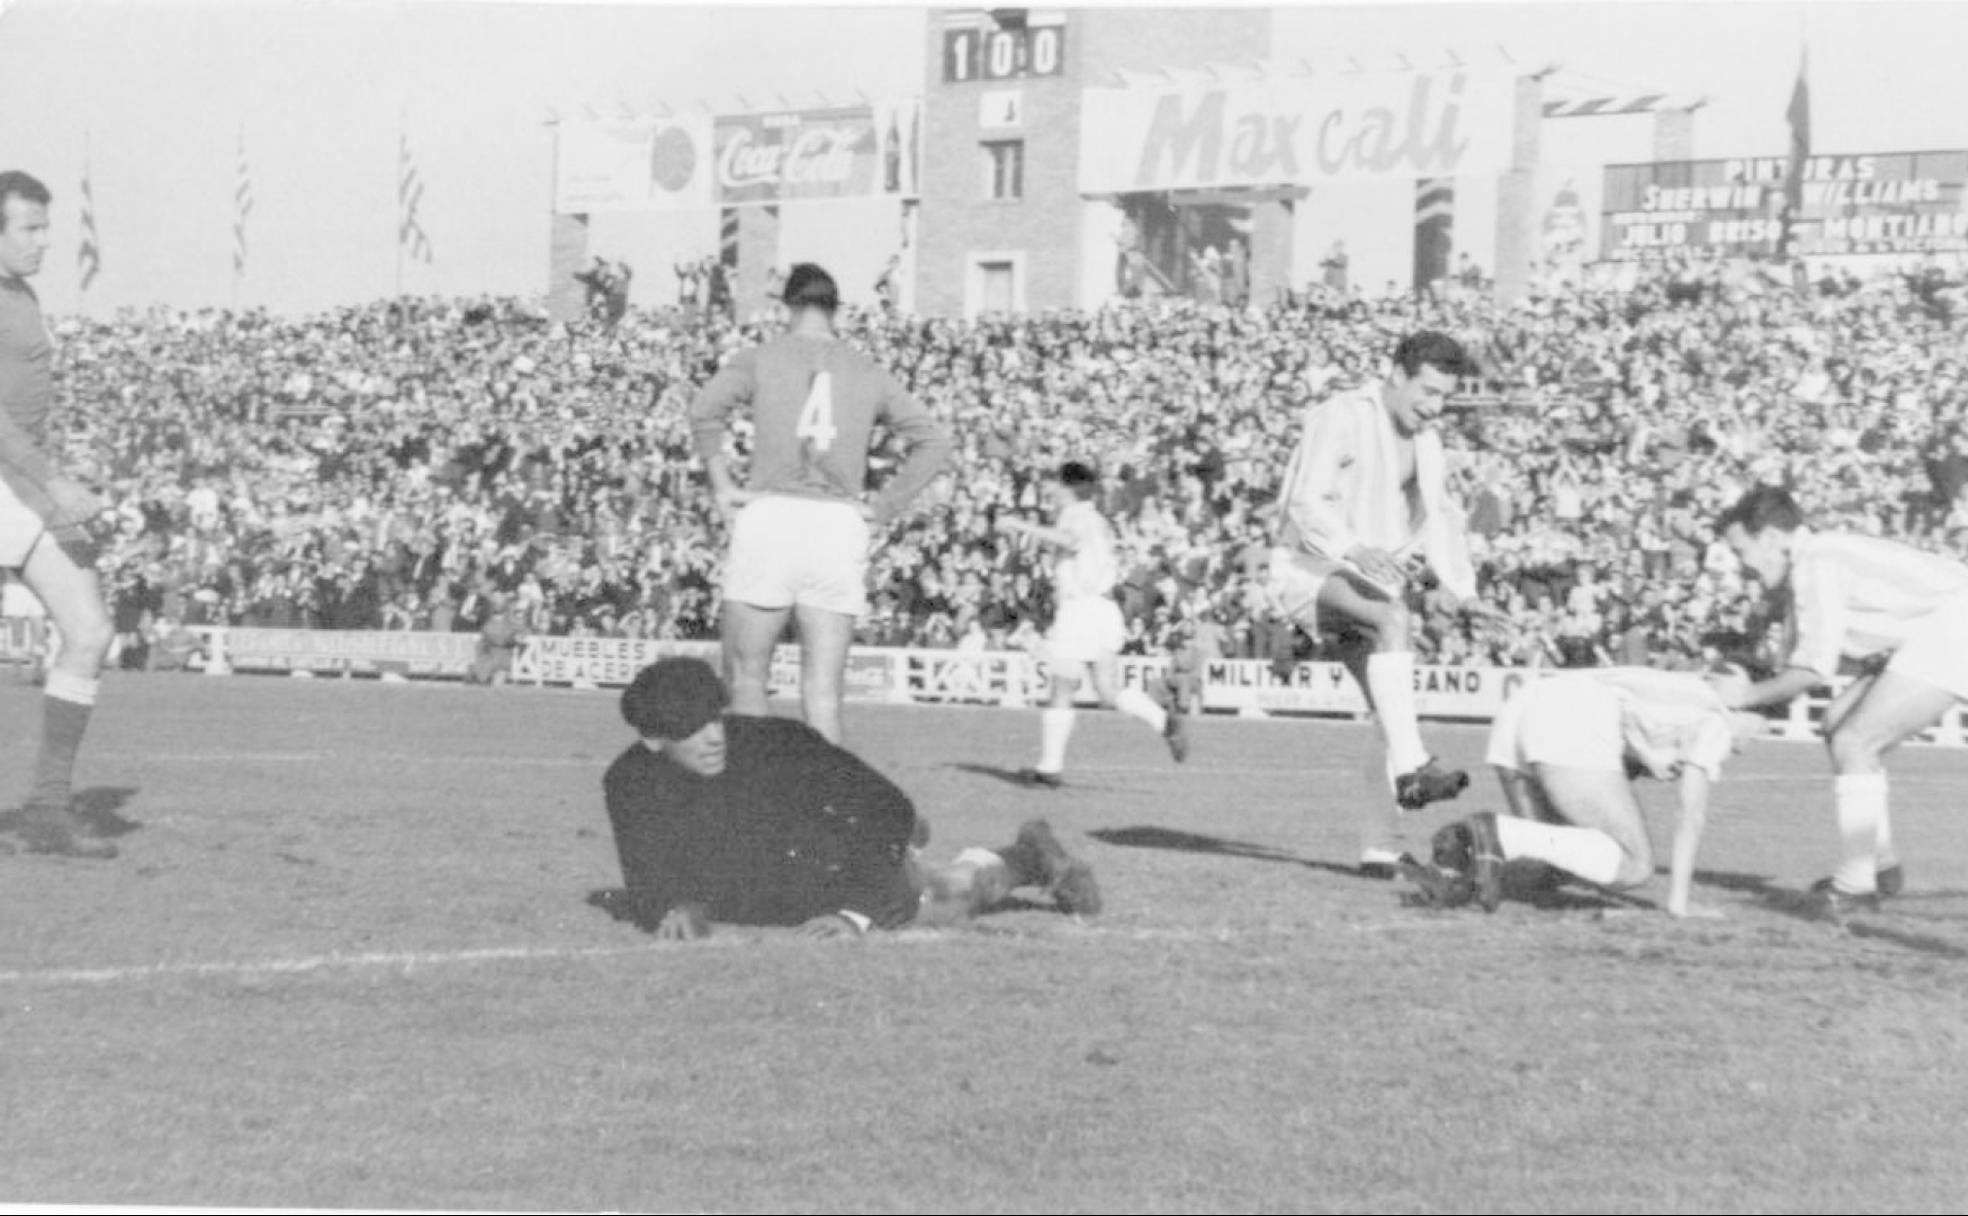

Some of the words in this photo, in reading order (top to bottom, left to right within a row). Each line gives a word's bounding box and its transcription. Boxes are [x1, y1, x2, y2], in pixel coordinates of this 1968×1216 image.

[1802, 180, 1939, 206] WILLIAMS
[796, 371, 838, 453] 4
[541, 640, 646, 661] MUEBLES
[574, 661, 645, 681] ACER
